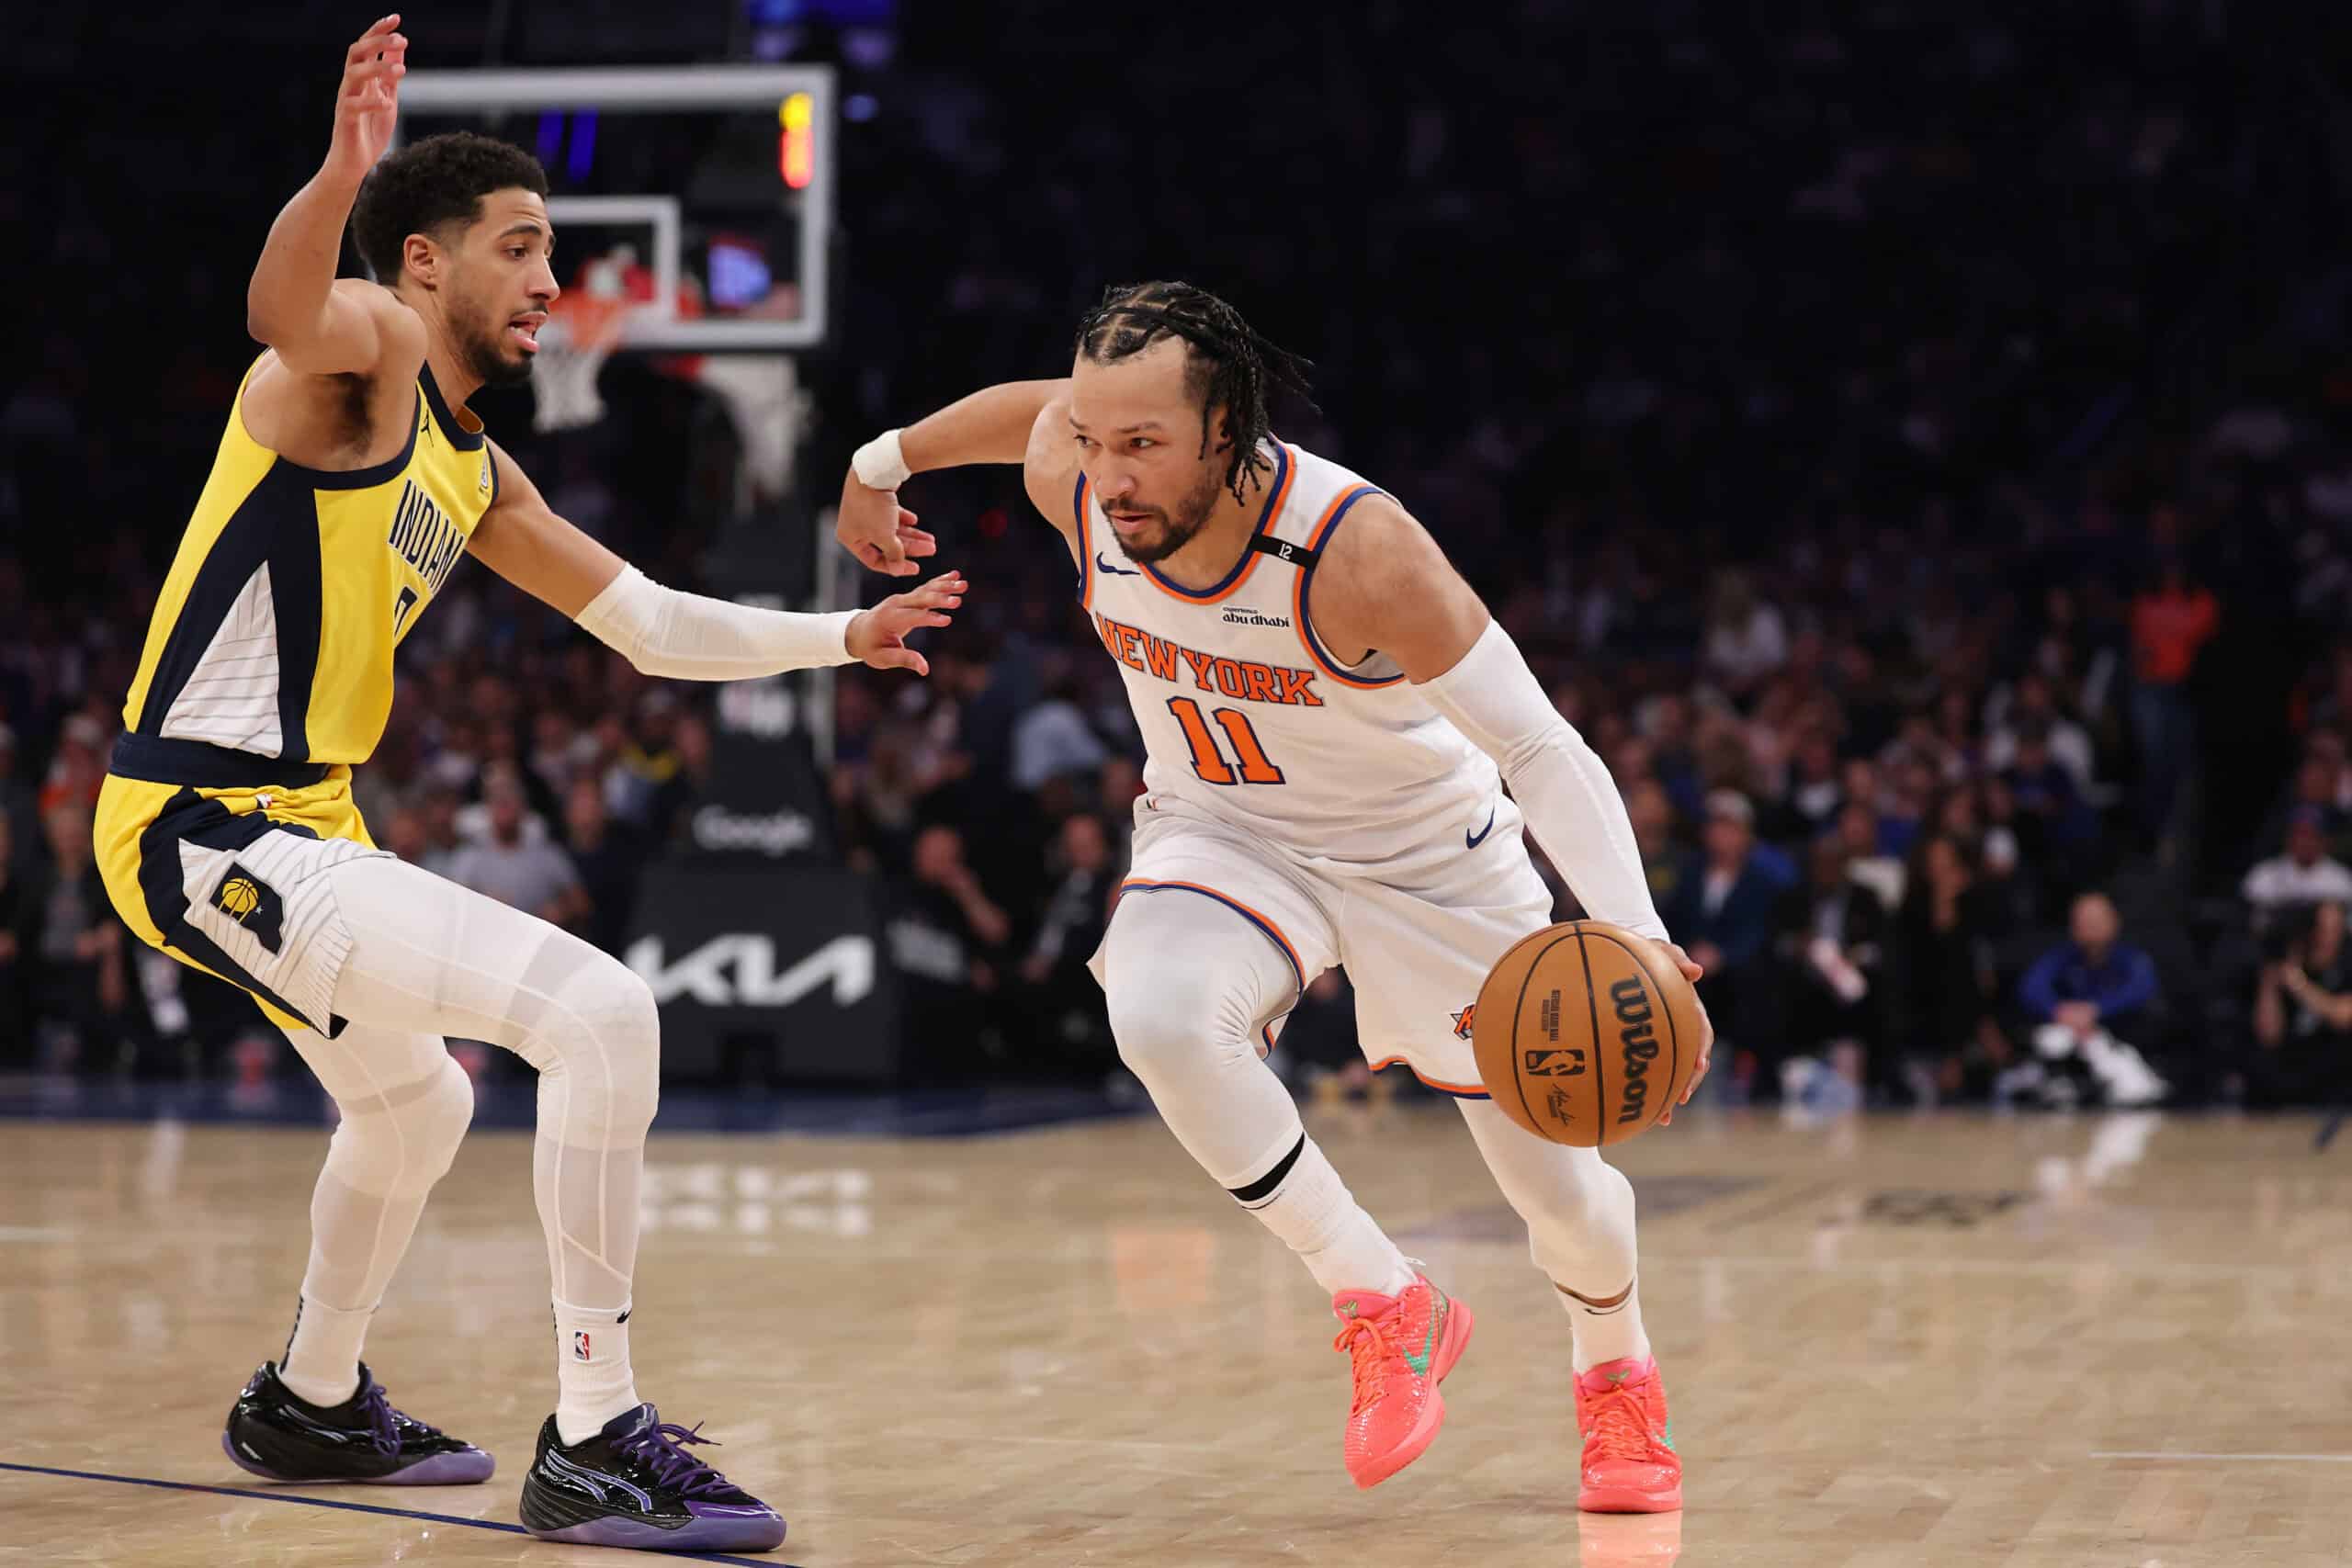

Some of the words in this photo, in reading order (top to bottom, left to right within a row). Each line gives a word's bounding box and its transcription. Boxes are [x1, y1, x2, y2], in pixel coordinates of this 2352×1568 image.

[1278, 543, 1293, 560] 12
[1095, 611, 1179, 682] NEW
[1180, 647, 1324, 706] YORK
[1223, 614, 1249, 625] abu
[1250, 615, 1290, 627] dhabi
[1167, 695, 1287, 786] 11
[625, 933, 875, 1007] KIA
[1611, 973, 1659, 1125] Wilson
